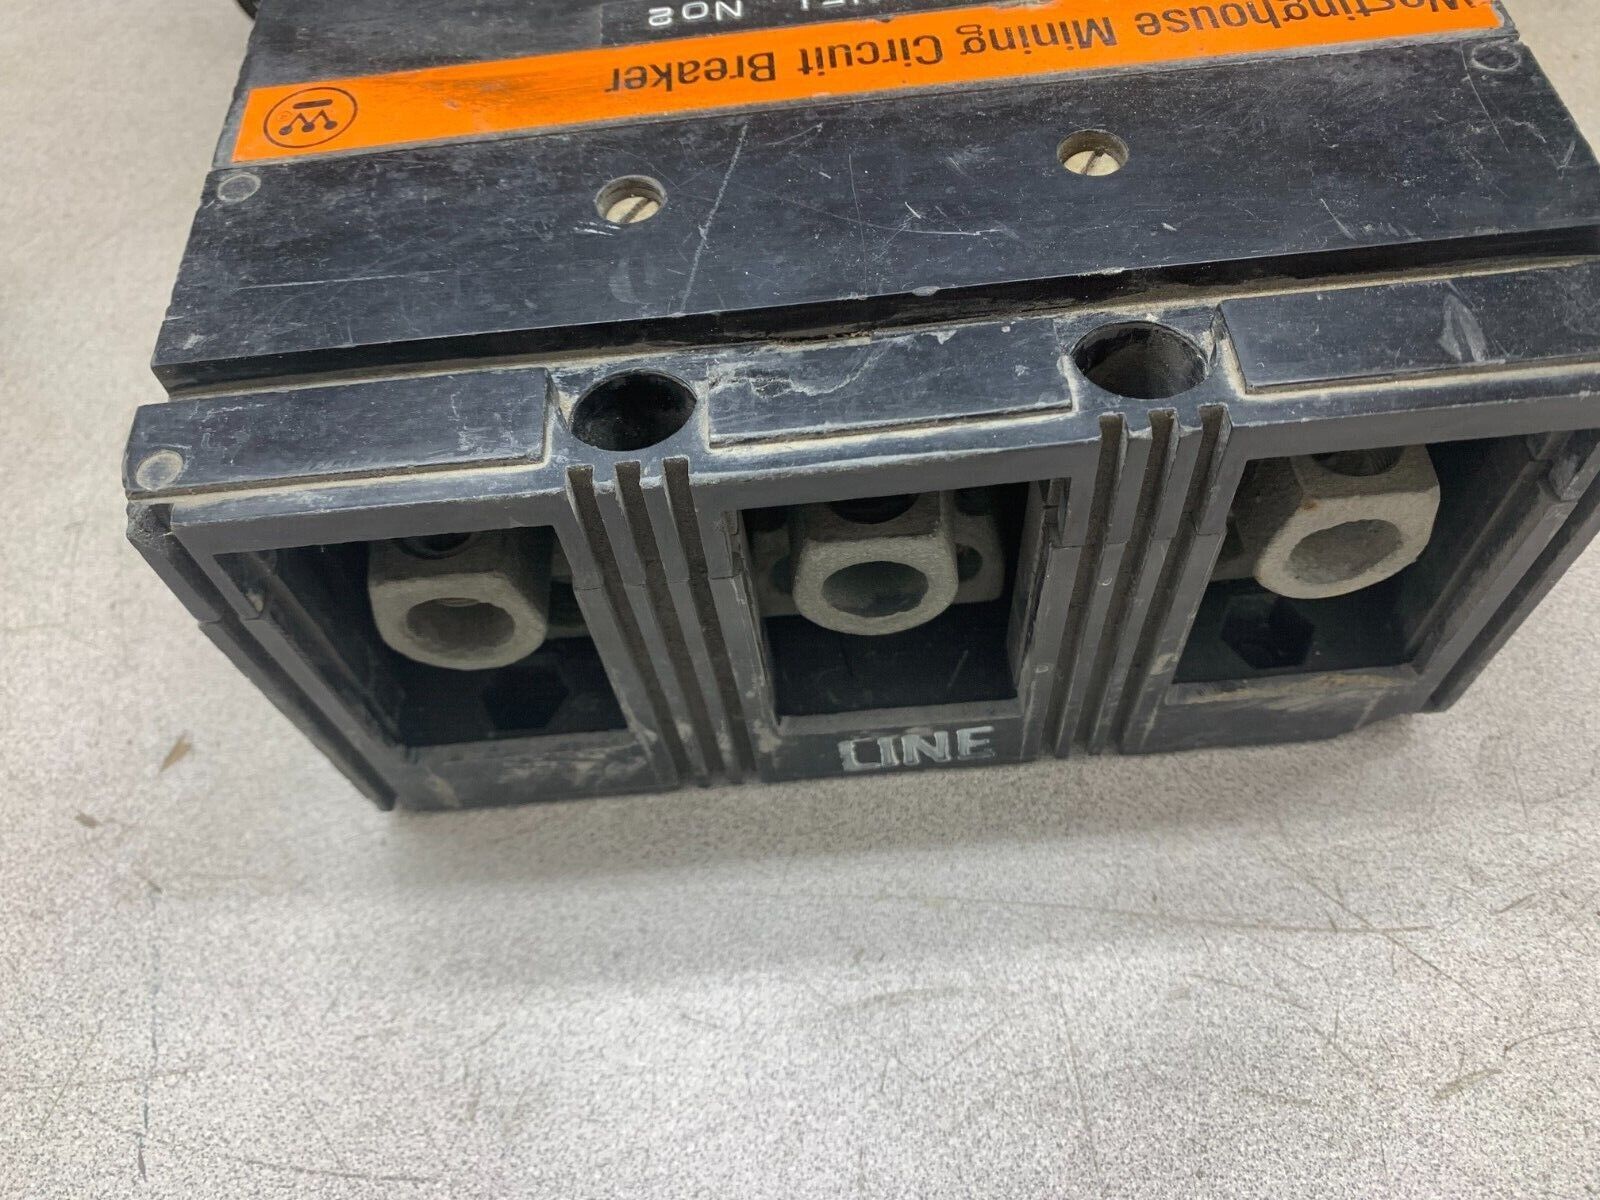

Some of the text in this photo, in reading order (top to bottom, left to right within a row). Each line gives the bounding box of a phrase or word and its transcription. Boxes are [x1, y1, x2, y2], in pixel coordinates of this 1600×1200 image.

[798, 35, 944, 77] Circuit
[956, 16, 1118, 55] Mining
[604, 52, 777, 92] Breaker
[837, 725, 995, 772] LINE
